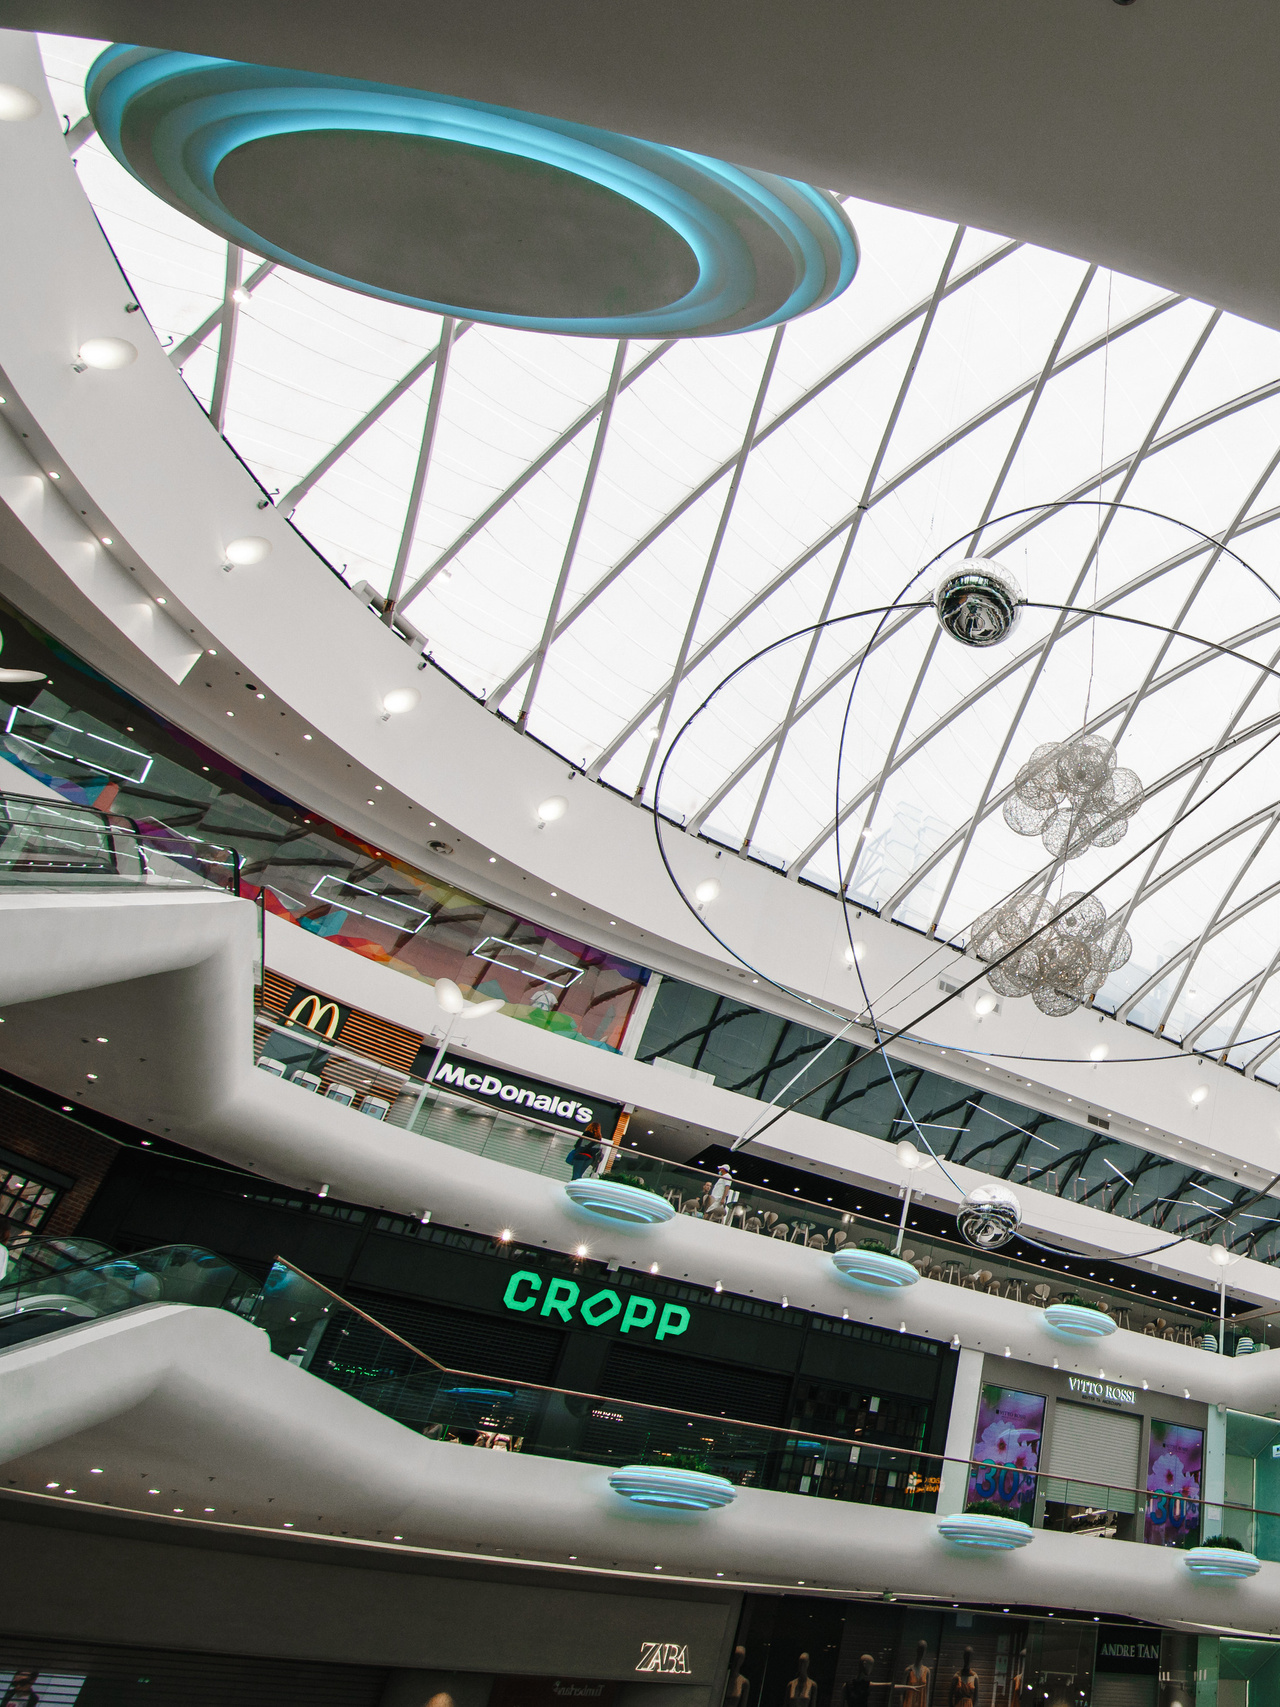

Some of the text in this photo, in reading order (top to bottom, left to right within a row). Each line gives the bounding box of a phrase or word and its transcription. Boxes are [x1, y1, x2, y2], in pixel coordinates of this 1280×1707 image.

[434, 1063, 594, 1124] McDonald's
[503, 1270, 691, 1341] CROPP
[1068, 1376, 1137, 1404] VITTO ROSSI
[635, 1641, 692, 1674] ZARA
[1101, 1643, 1160, 1660] ANDRE TAN
